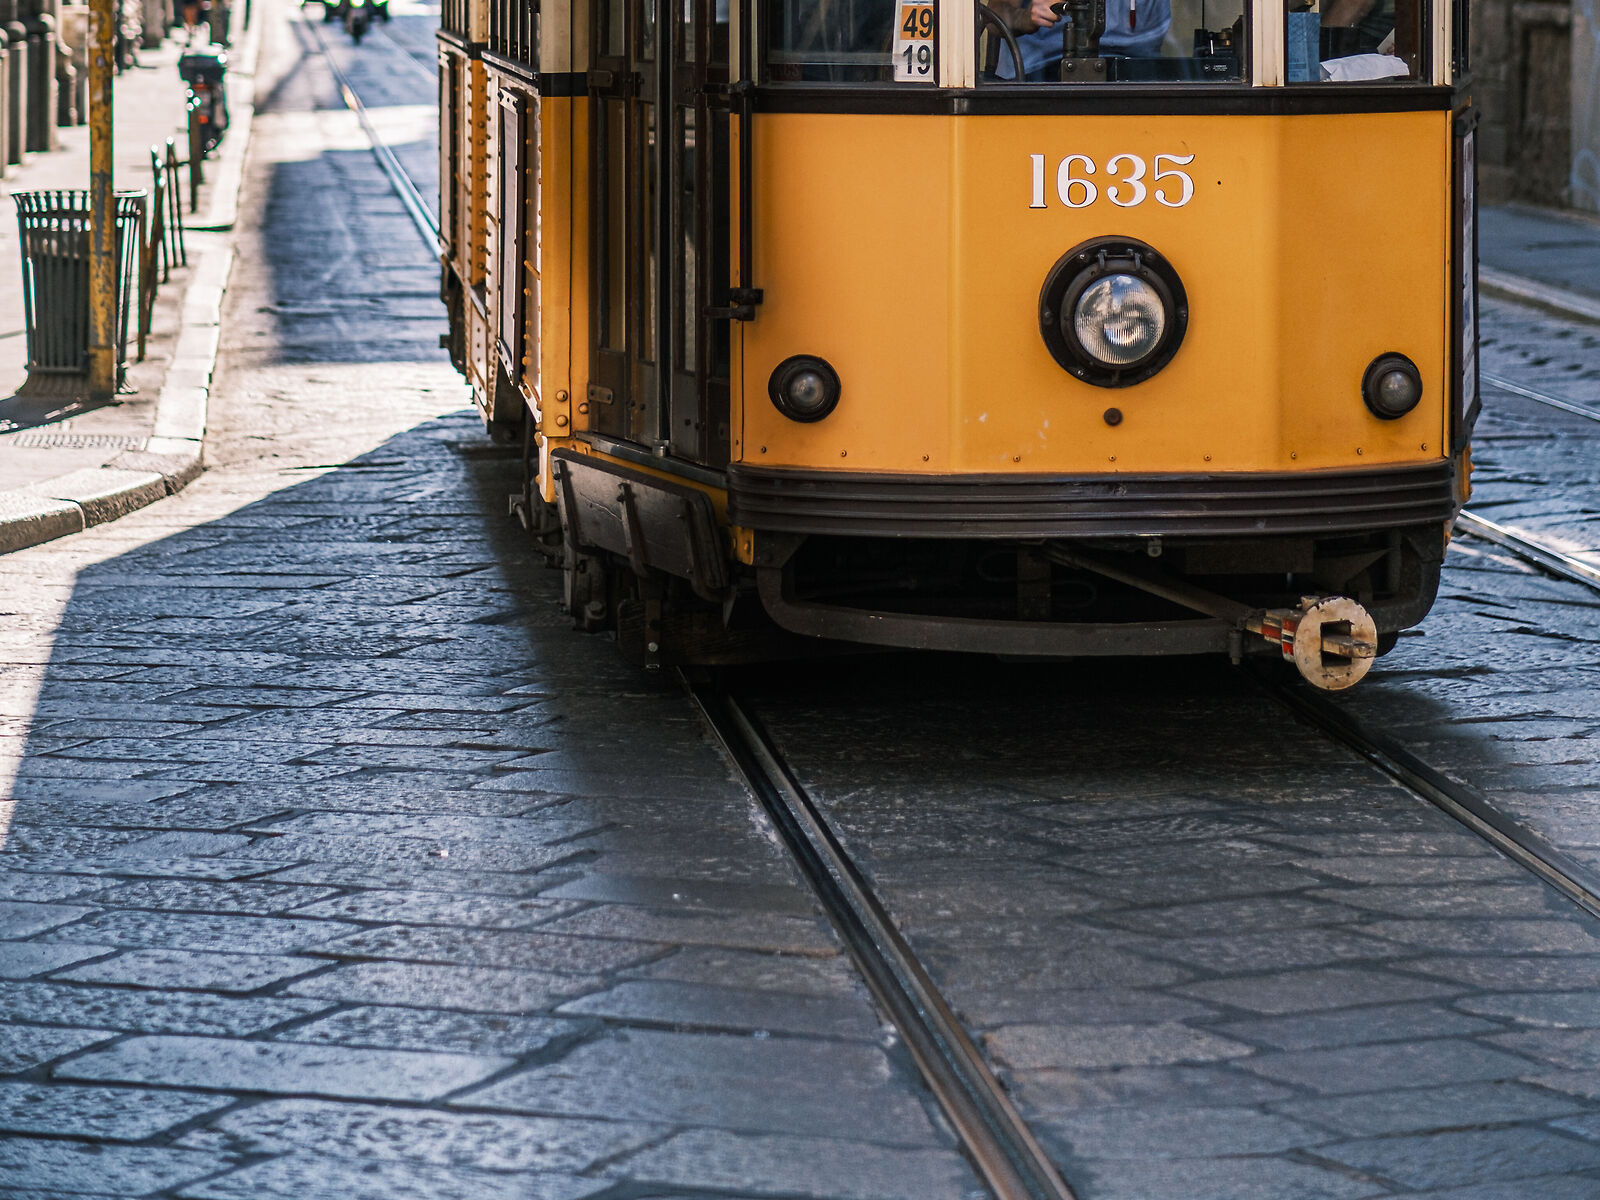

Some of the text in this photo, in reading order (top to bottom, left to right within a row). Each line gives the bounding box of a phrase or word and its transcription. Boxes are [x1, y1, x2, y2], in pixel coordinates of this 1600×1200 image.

[903, 8, 933, 38] 49
[902, 44, 931, 75] 19
[1029, 153, 1195, 208] 1635
